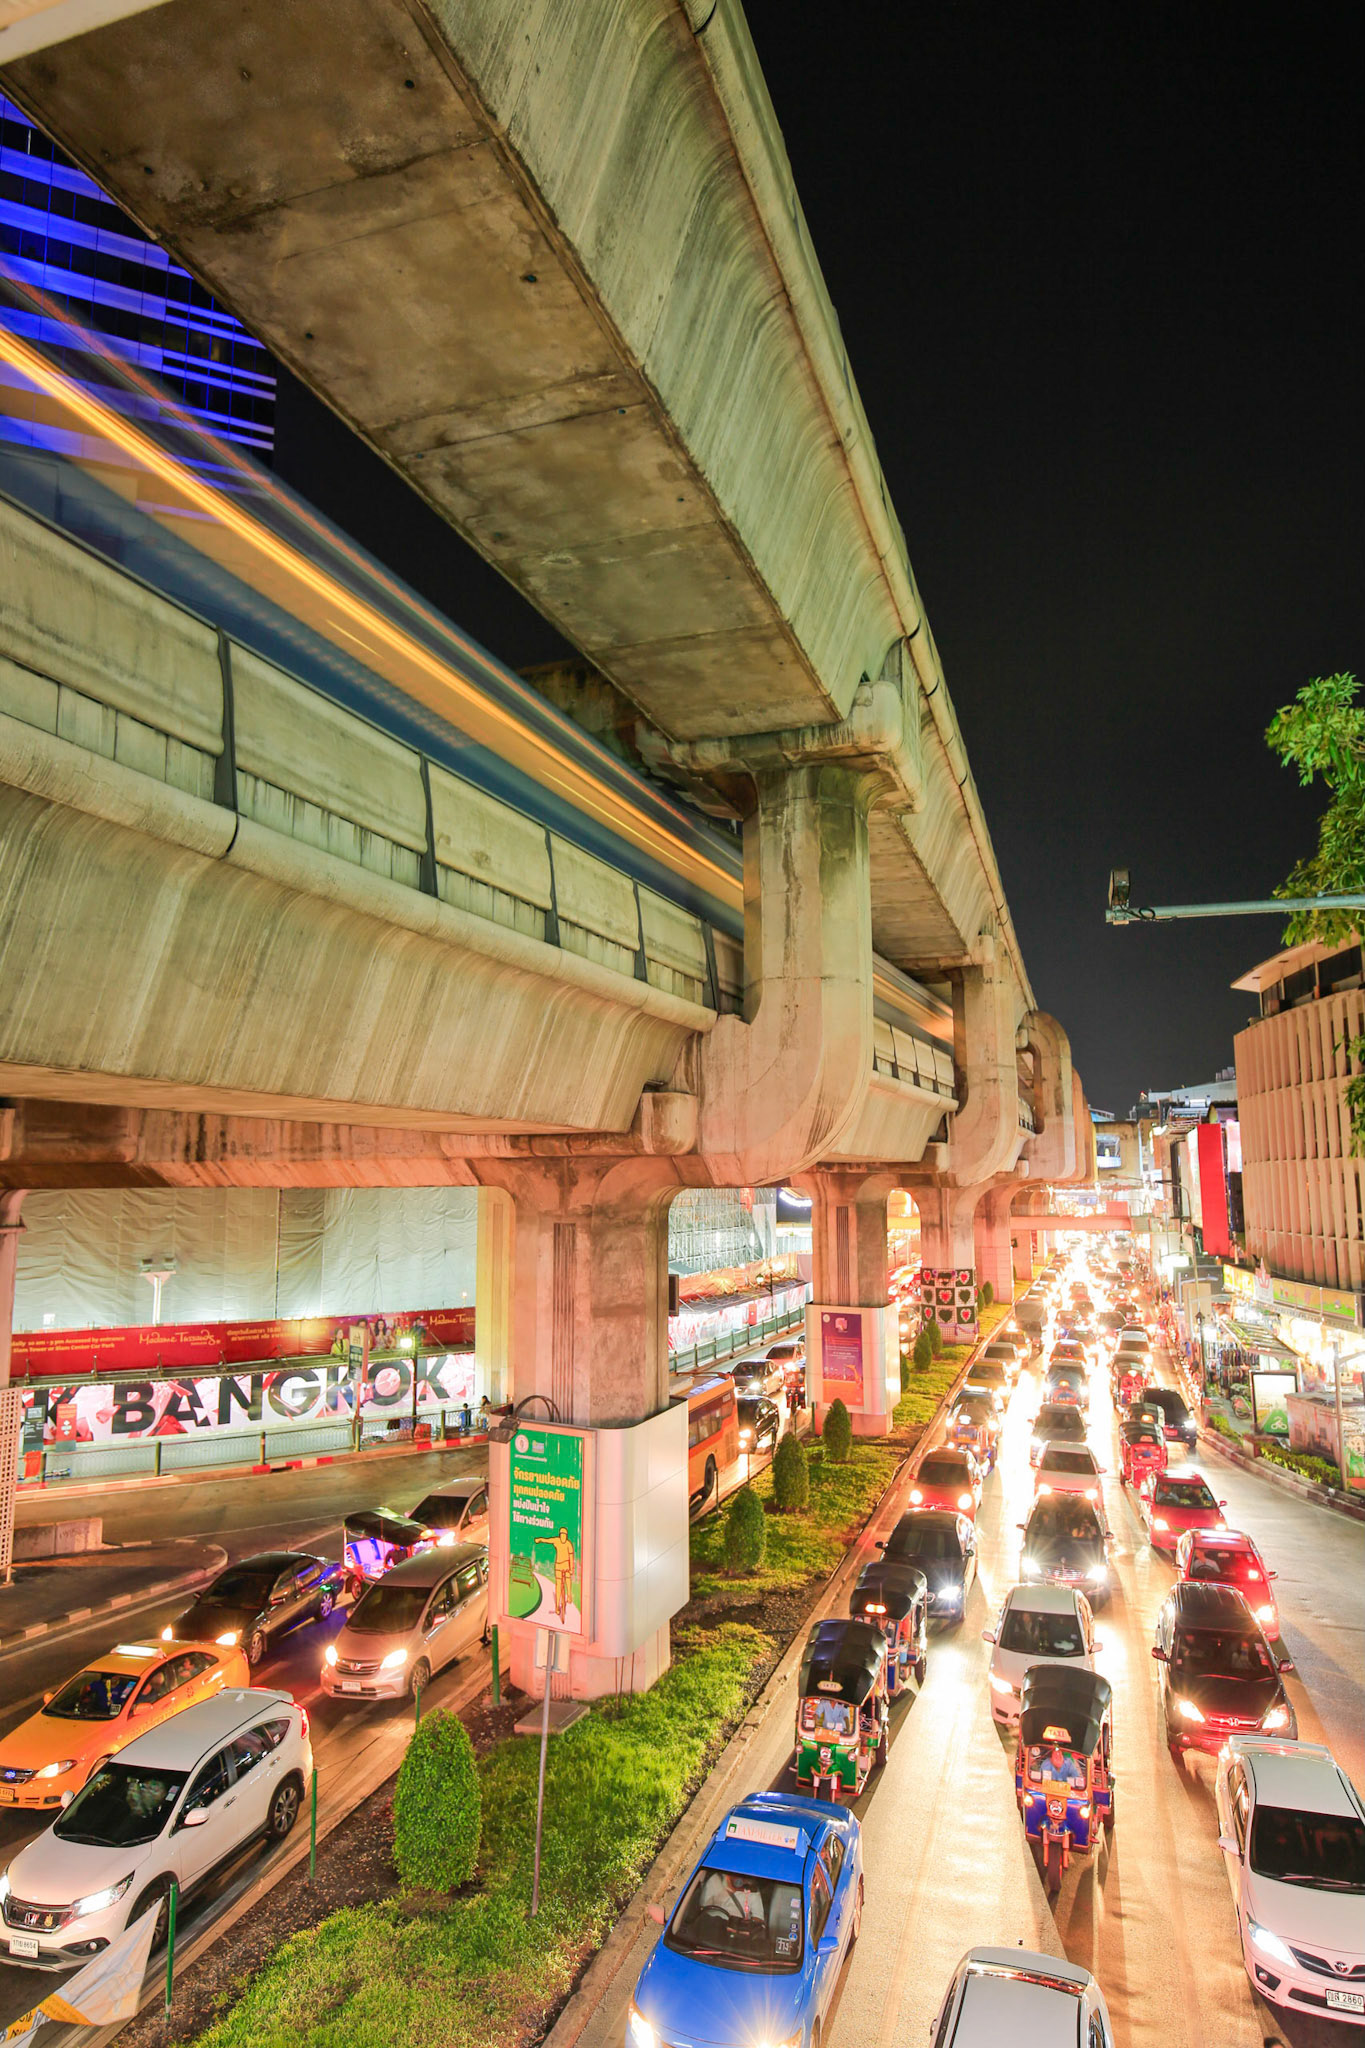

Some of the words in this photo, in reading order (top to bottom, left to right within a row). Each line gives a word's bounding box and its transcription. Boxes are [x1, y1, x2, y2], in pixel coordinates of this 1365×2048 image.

[139, 1331, 177, 1345] Madame
[111, 1355, 451, 1434] BANGKOK
[514, 1466, 580, 1490] จักรยานปลอดภัย
[513, 1484, 565, 1502] ทุกคนปลอดภัย
[1342, 1993, 1363, 2005] 2860
